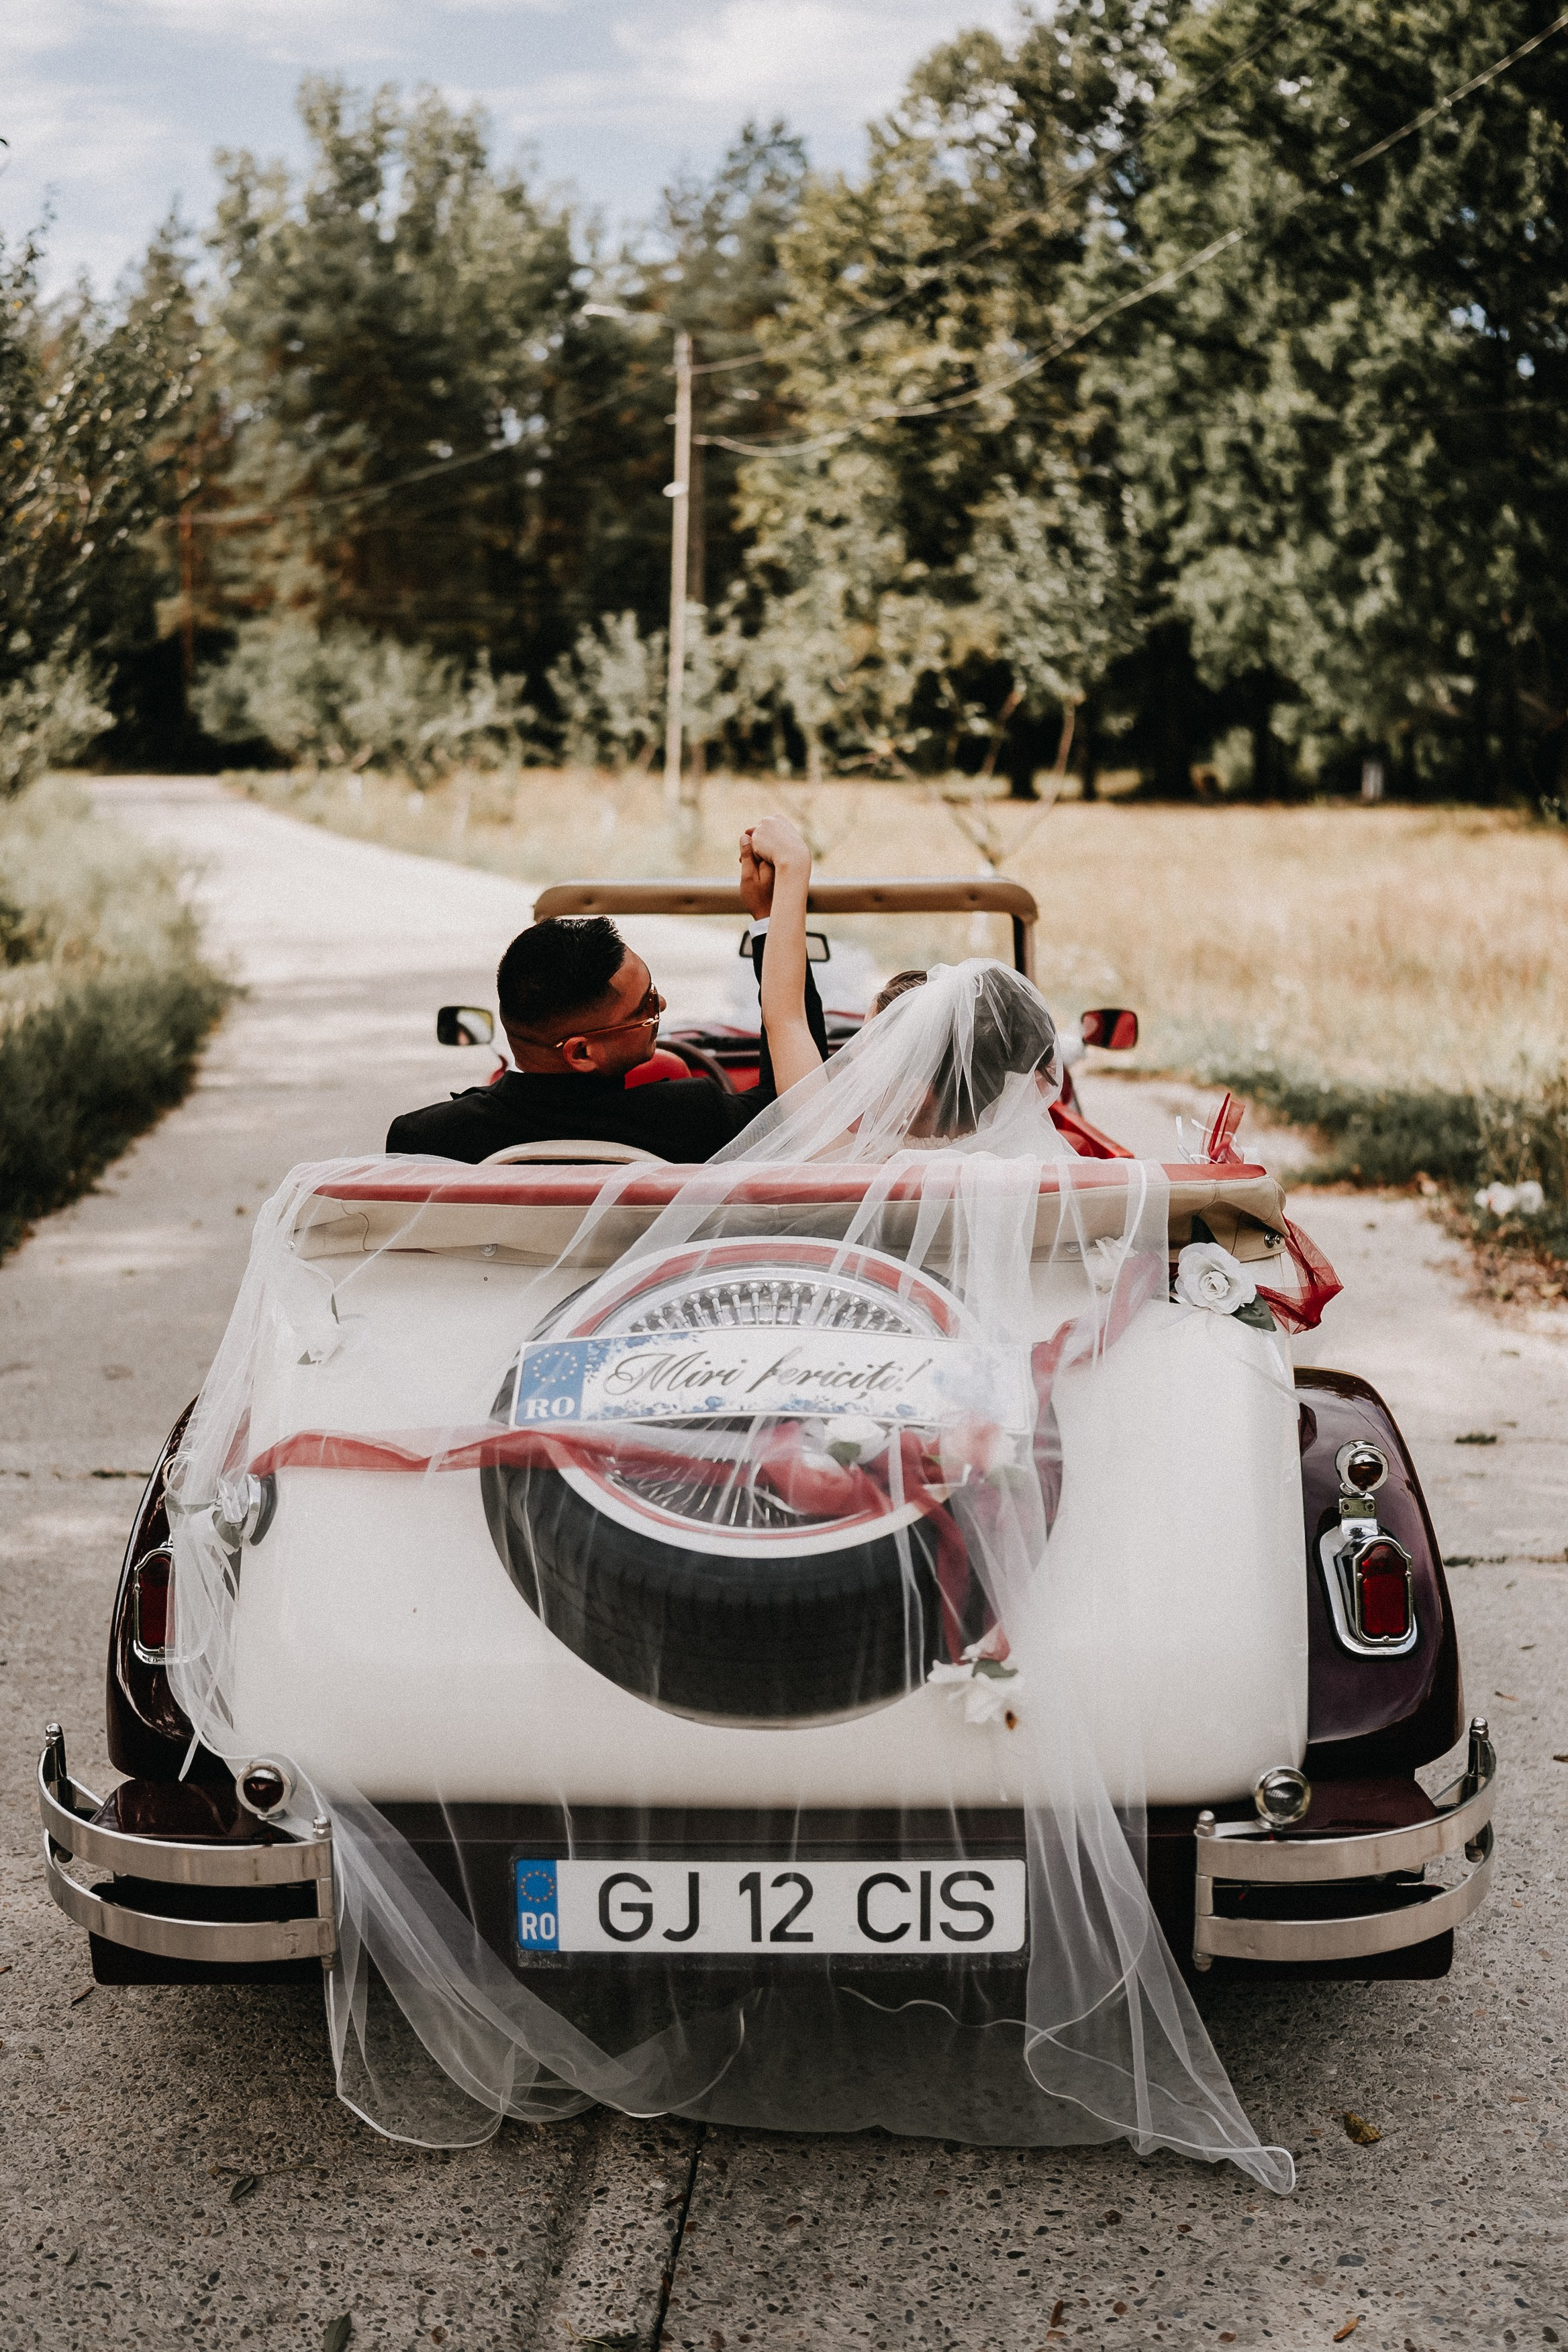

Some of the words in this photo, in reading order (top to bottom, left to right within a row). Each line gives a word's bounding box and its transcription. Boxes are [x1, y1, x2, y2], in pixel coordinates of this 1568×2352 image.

[604, 1350, 747, 1395] Miri
[524, 1395, 576, 1420] RO
[597, 1871, 700, 1943] GJ
[738, 1871, 814, 1943] 12
[856, 1870, 995, 1943] CIS
[521, 1911, 556, 1942] RO
